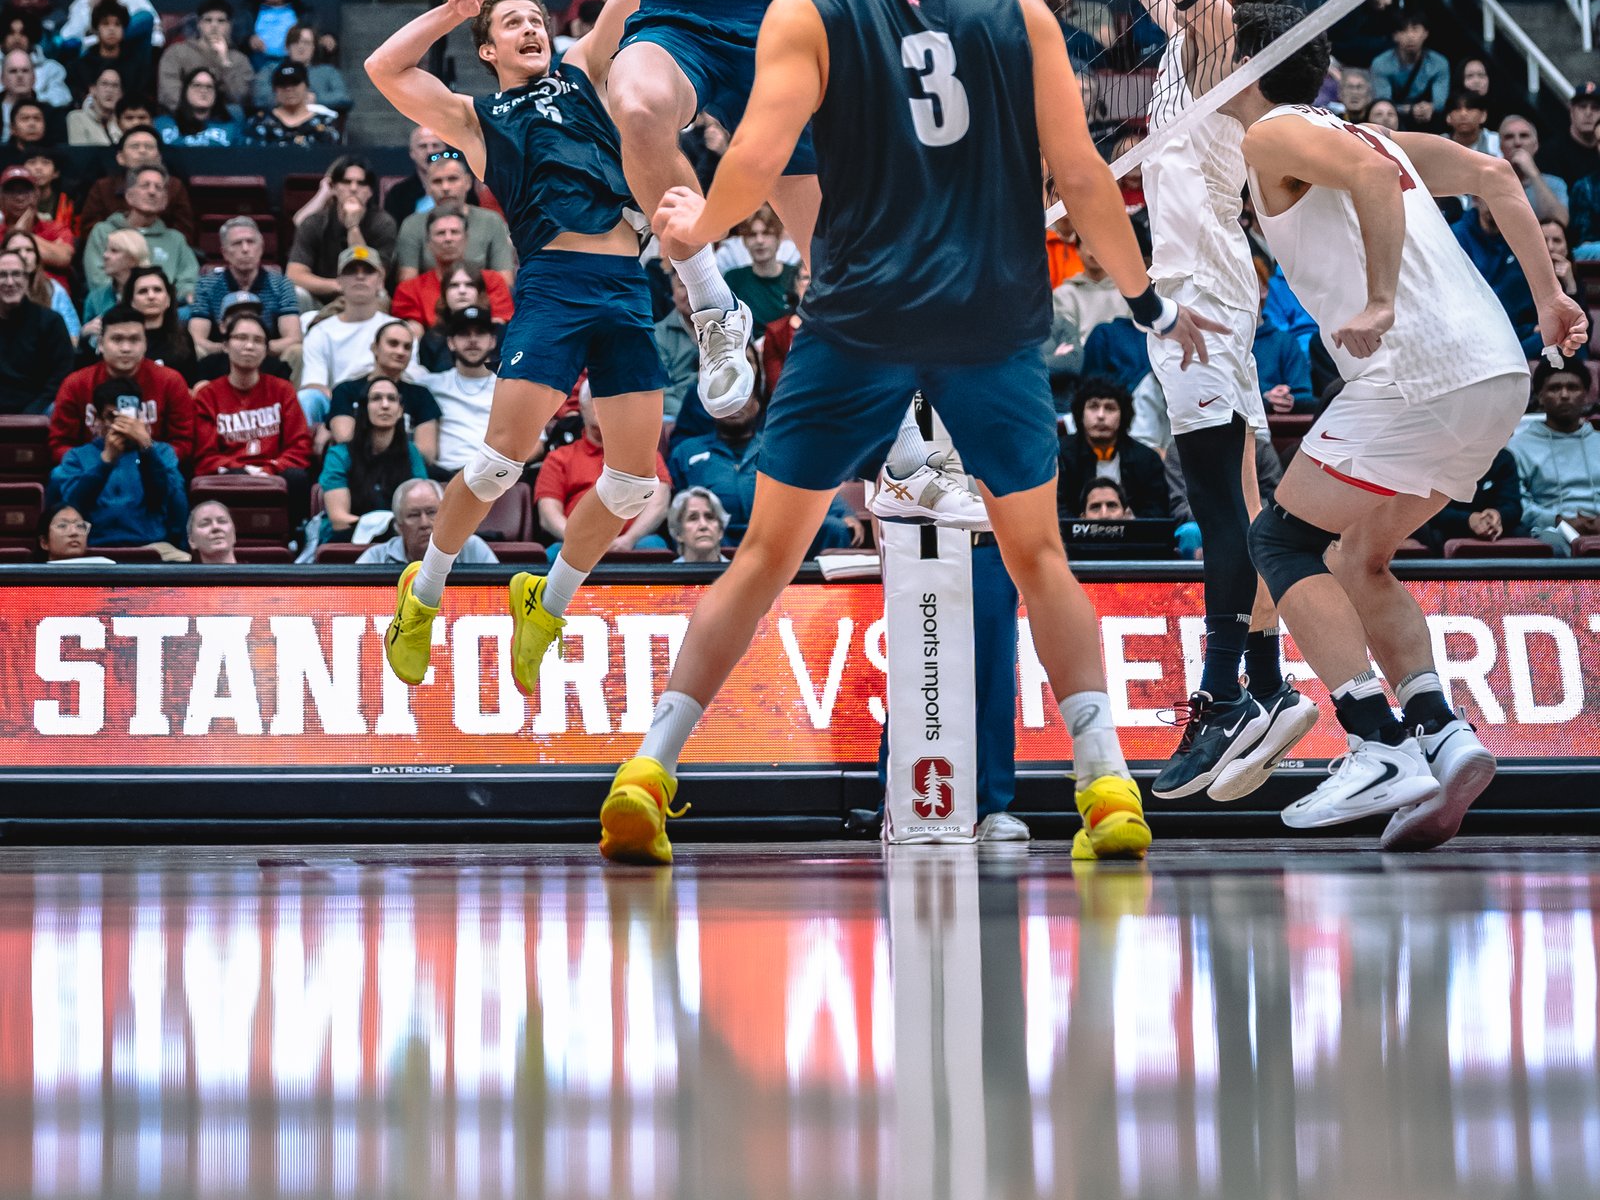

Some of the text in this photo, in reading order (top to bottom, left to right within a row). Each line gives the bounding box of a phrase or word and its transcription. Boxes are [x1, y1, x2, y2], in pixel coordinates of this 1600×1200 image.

[902, 30, 970, 147] 3
[534, 96, 563, 124] 5
[216, 402, 281, 435] STANFORD
[919, 592, 943, 741] sports imports
[371, 765, 453, 775] DAKTRONICS
